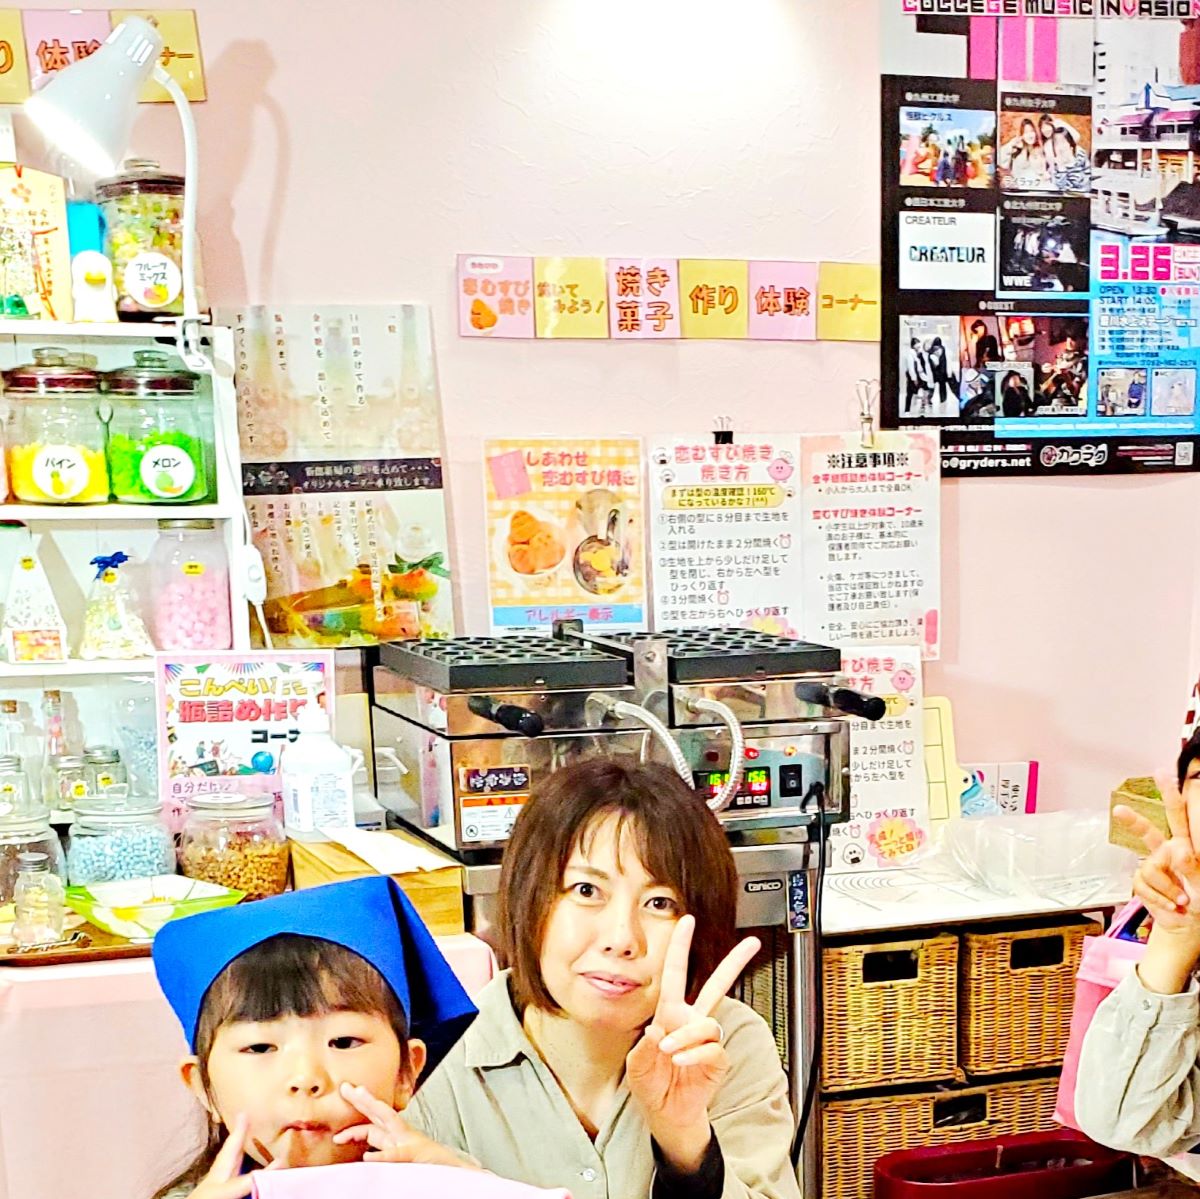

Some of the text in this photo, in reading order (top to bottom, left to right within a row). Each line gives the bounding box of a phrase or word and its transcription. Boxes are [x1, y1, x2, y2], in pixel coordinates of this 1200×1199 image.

[1026, 0, 1092, 15] MUSIC
[908, 245, 986, 264] CREATEUR
[1100, 244, 1172, 281] 3.26
[615, 266, 671, 299] 焼き
[1002, 275, 1033, 288] WWE
[688, 285, 739, 316] 作り
[754, 286, 811, 317] 体験
[821, 293, 877, 311] コーナー
[618, 301, 674, 333] 菓子
[526, 450, 589, 467] しあわせ
[674, 443, 774, 463] 恋むすび焼き
[44, 456, 76, 470] パイン
[151, 456, 181, 470] メロン
[541, 469, 636, 487] 恋むすび焼き
[700, 464, 751, 482] 焼き方
[667, 524, 697, 535] 入れる
[670, 580, 726, 592] ひっくり返す
[179, 677, 308, 697] こんぺい
[851, 719, 912, 731] 分目まで生地を
[747, 880, 781, 893] tanico
